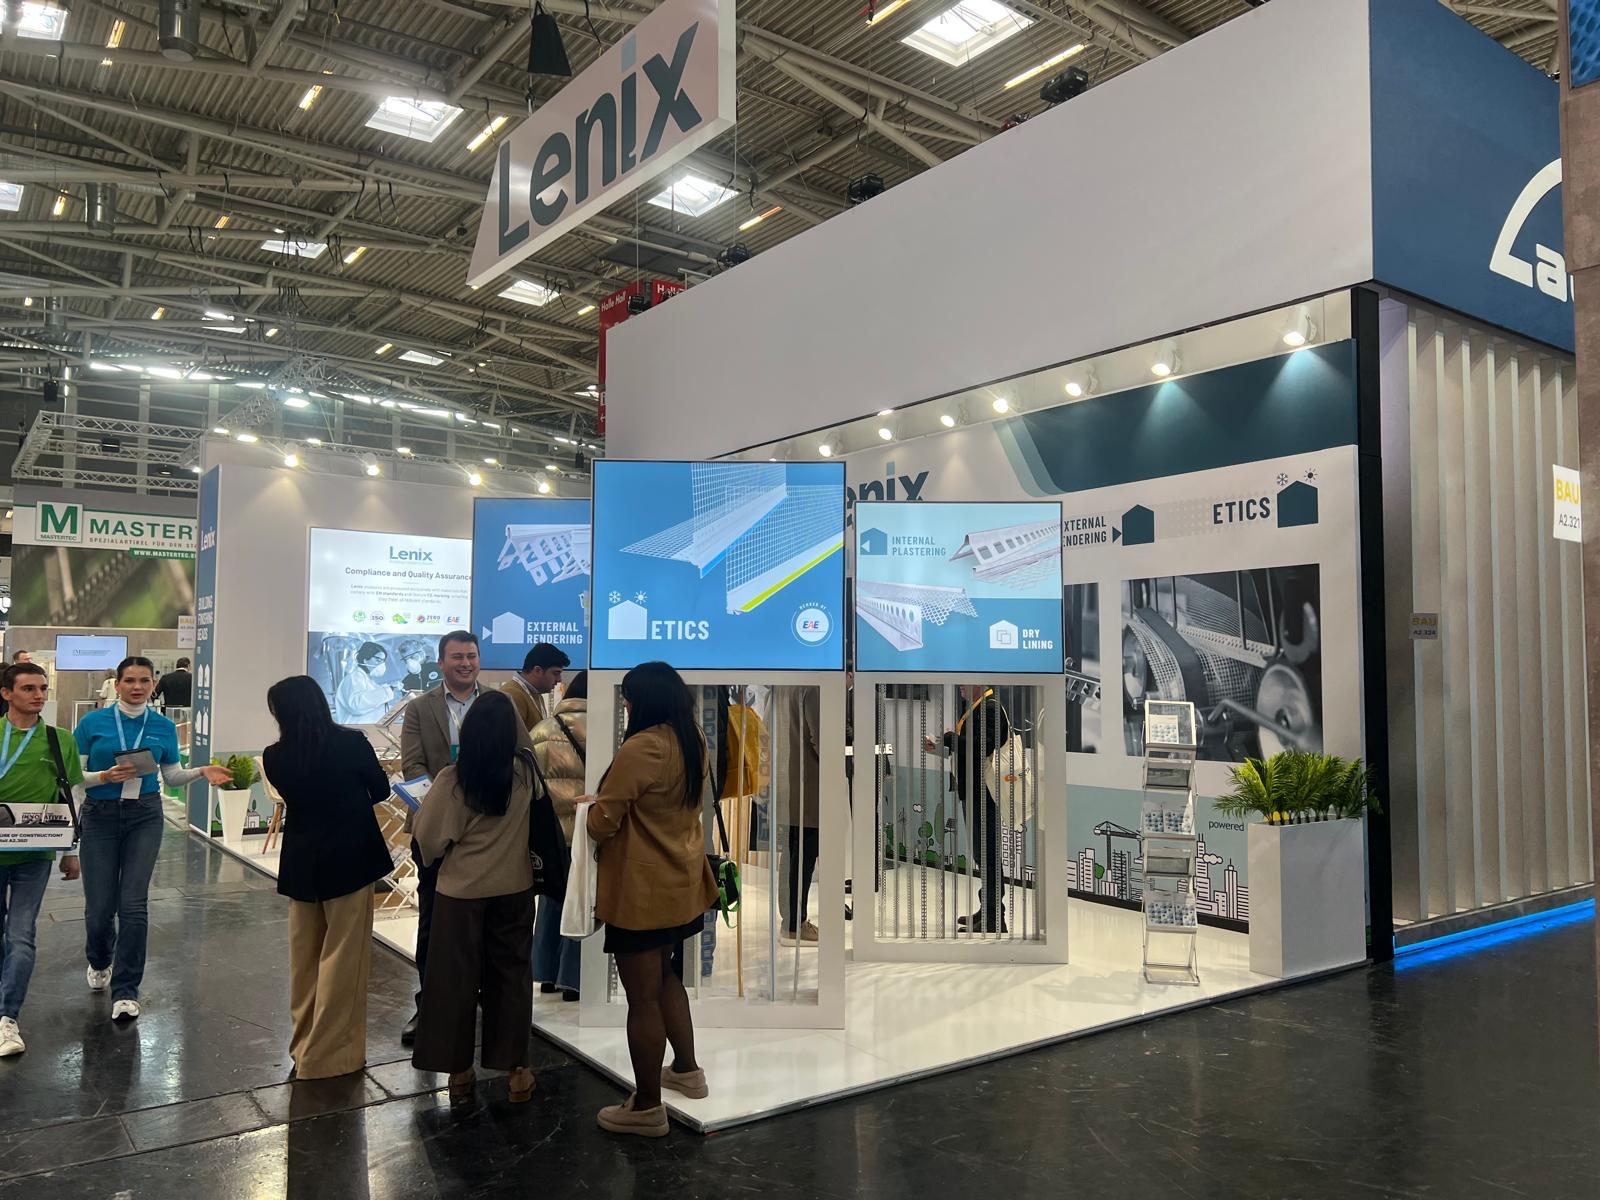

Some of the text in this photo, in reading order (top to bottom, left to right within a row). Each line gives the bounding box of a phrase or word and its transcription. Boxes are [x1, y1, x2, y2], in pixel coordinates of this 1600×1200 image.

[498, 21, 702, 256] Lenix
[1489, 158, 1575, 302] La
[1556, 479, 1580, 504] BAU
[1213, 497, 1271, 525] ETICS
[40, 504, 78, 534] M
[1064, 516, 1106, 531] XTERNAL
[90, 519, 197, 540] MASTER
[200, 526, 215, 551] Lenix
[892, 536, 935, 545] INTERNAL
[1063, 531, 1107, 547] NDERING
[389, 546, 433, 561] Lenix
[892, 547, 946, 556] PLASTERING
[345, 567, 391, 577] Compliance
[392, 570, 407, 578] and
[408, 570, 434, 580] Quality
[527, 621, 578, 631] EXTERNAL
[651, 620, 709, 640] ETICS
[803, 620, 820, 629] EAE
[527, 634, 583, 644] RENDERING
[1022, 629, 1040, 638] DRY
[1022, 640, 1053, 650] LINING
[1208, 820, 1245, 832] powered
